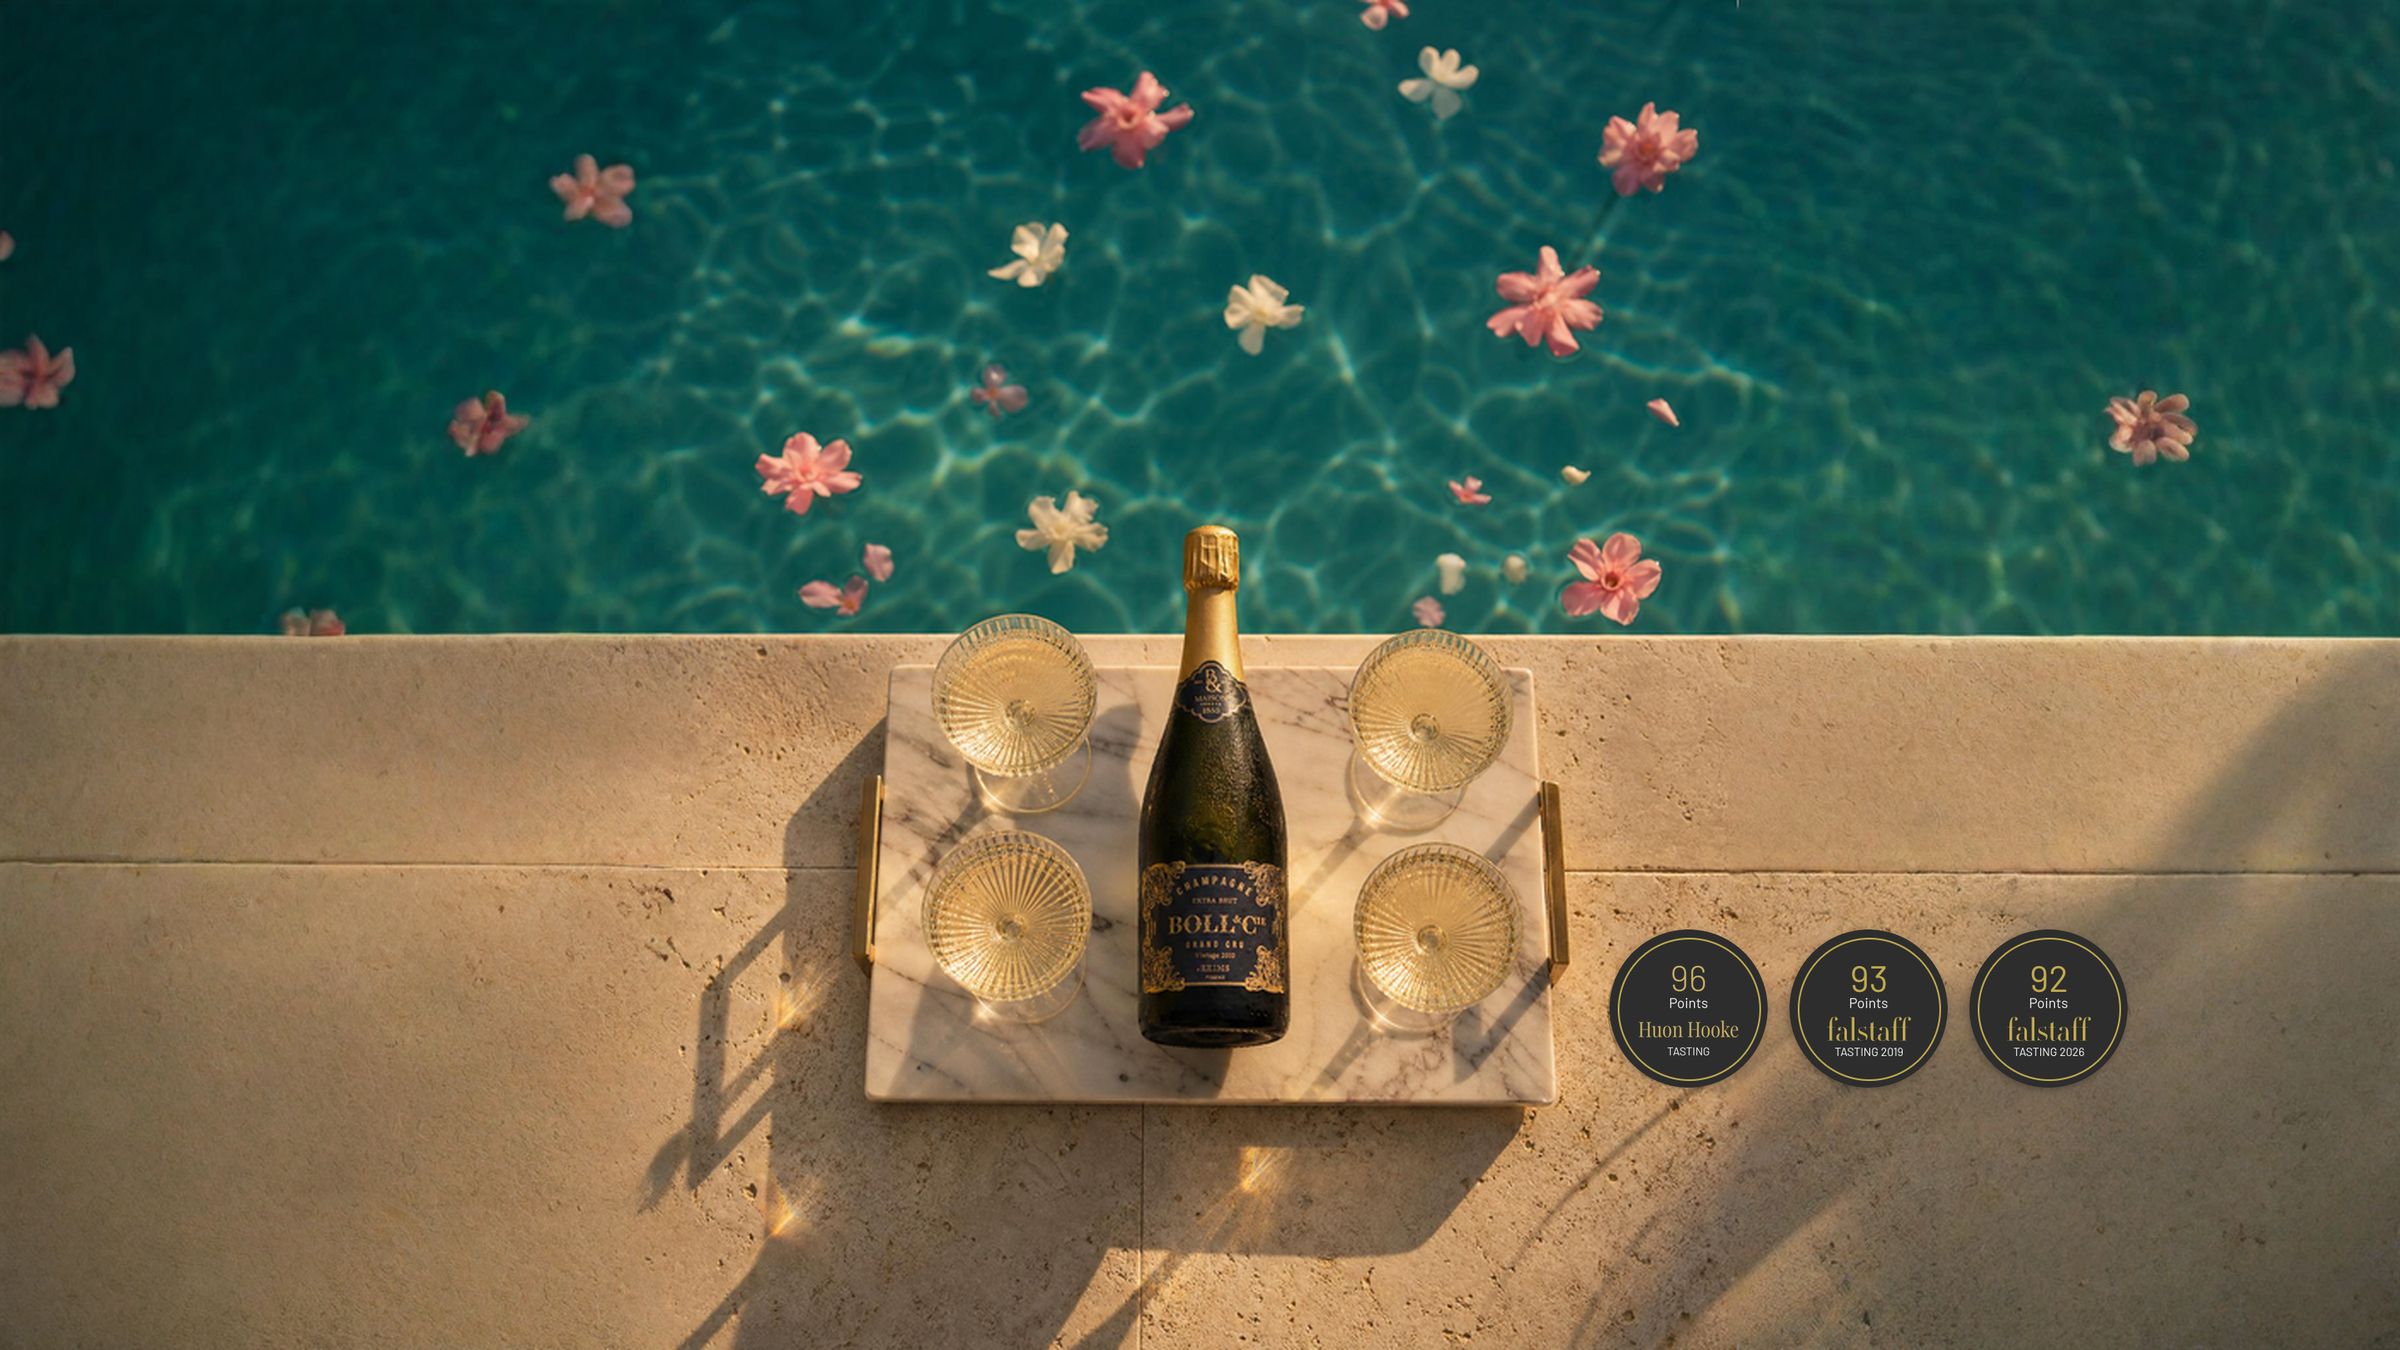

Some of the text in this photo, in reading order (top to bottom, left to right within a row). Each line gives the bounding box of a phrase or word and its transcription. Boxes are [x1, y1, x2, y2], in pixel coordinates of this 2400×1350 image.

[1176, 875, 1253, 897] CHAMPAGNE
[1186, 940, 1245, 949] GRAND CRU
